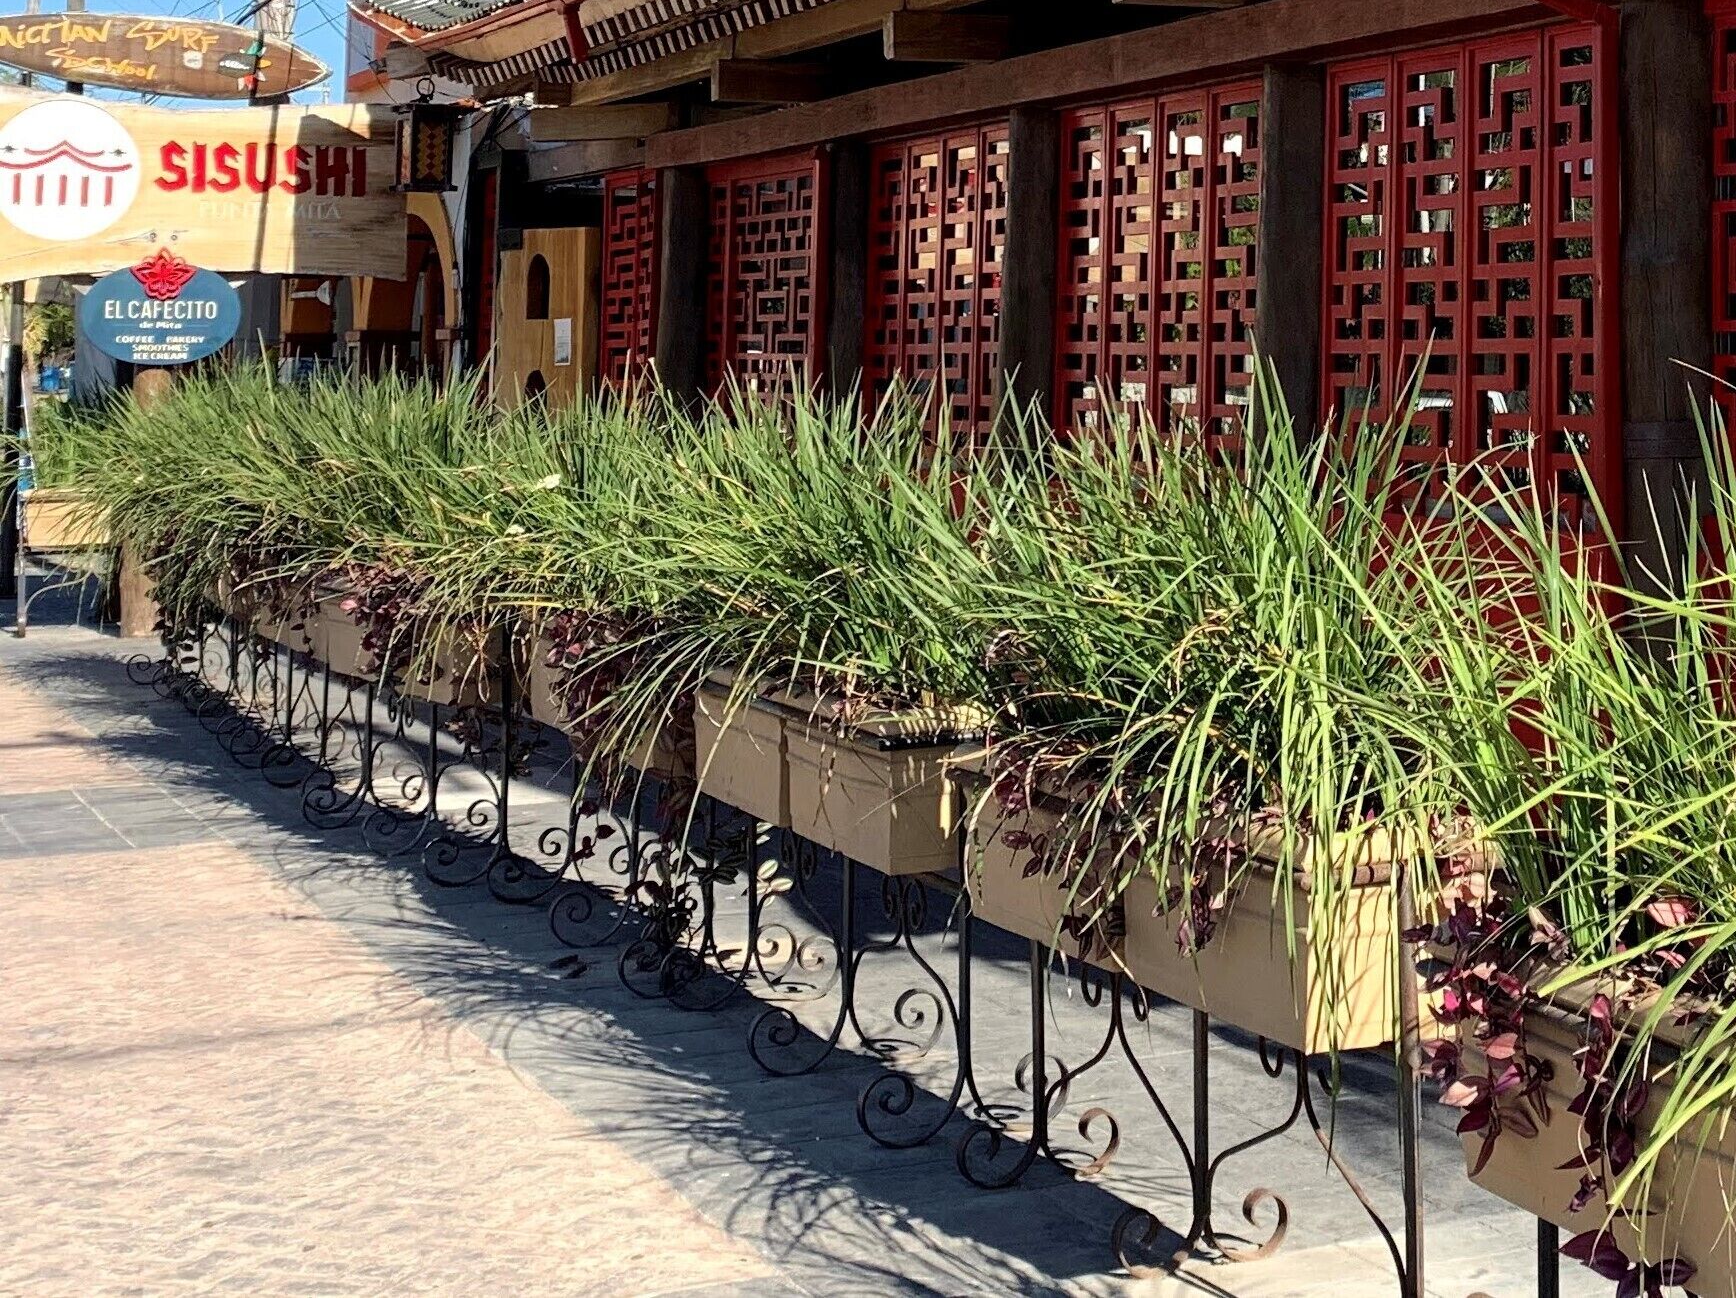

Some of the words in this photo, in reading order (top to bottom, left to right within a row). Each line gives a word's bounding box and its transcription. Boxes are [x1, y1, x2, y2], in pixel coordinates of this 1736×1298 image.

[126, 21, 220, 53] SURF
[153, 140, 367, 198] SISUSHI
[104, 300, 123, 319] EL
[128, 300, 217, 320] CAFECITO
[115, 335, 155, 344] COFFEE
[166, 335, 206, 344] BAKERY
[132, 343, 190, 352] SMOOTHIES
[133, 352, 150, 360] ICE
[151, 352, 188, 360] CREAM
